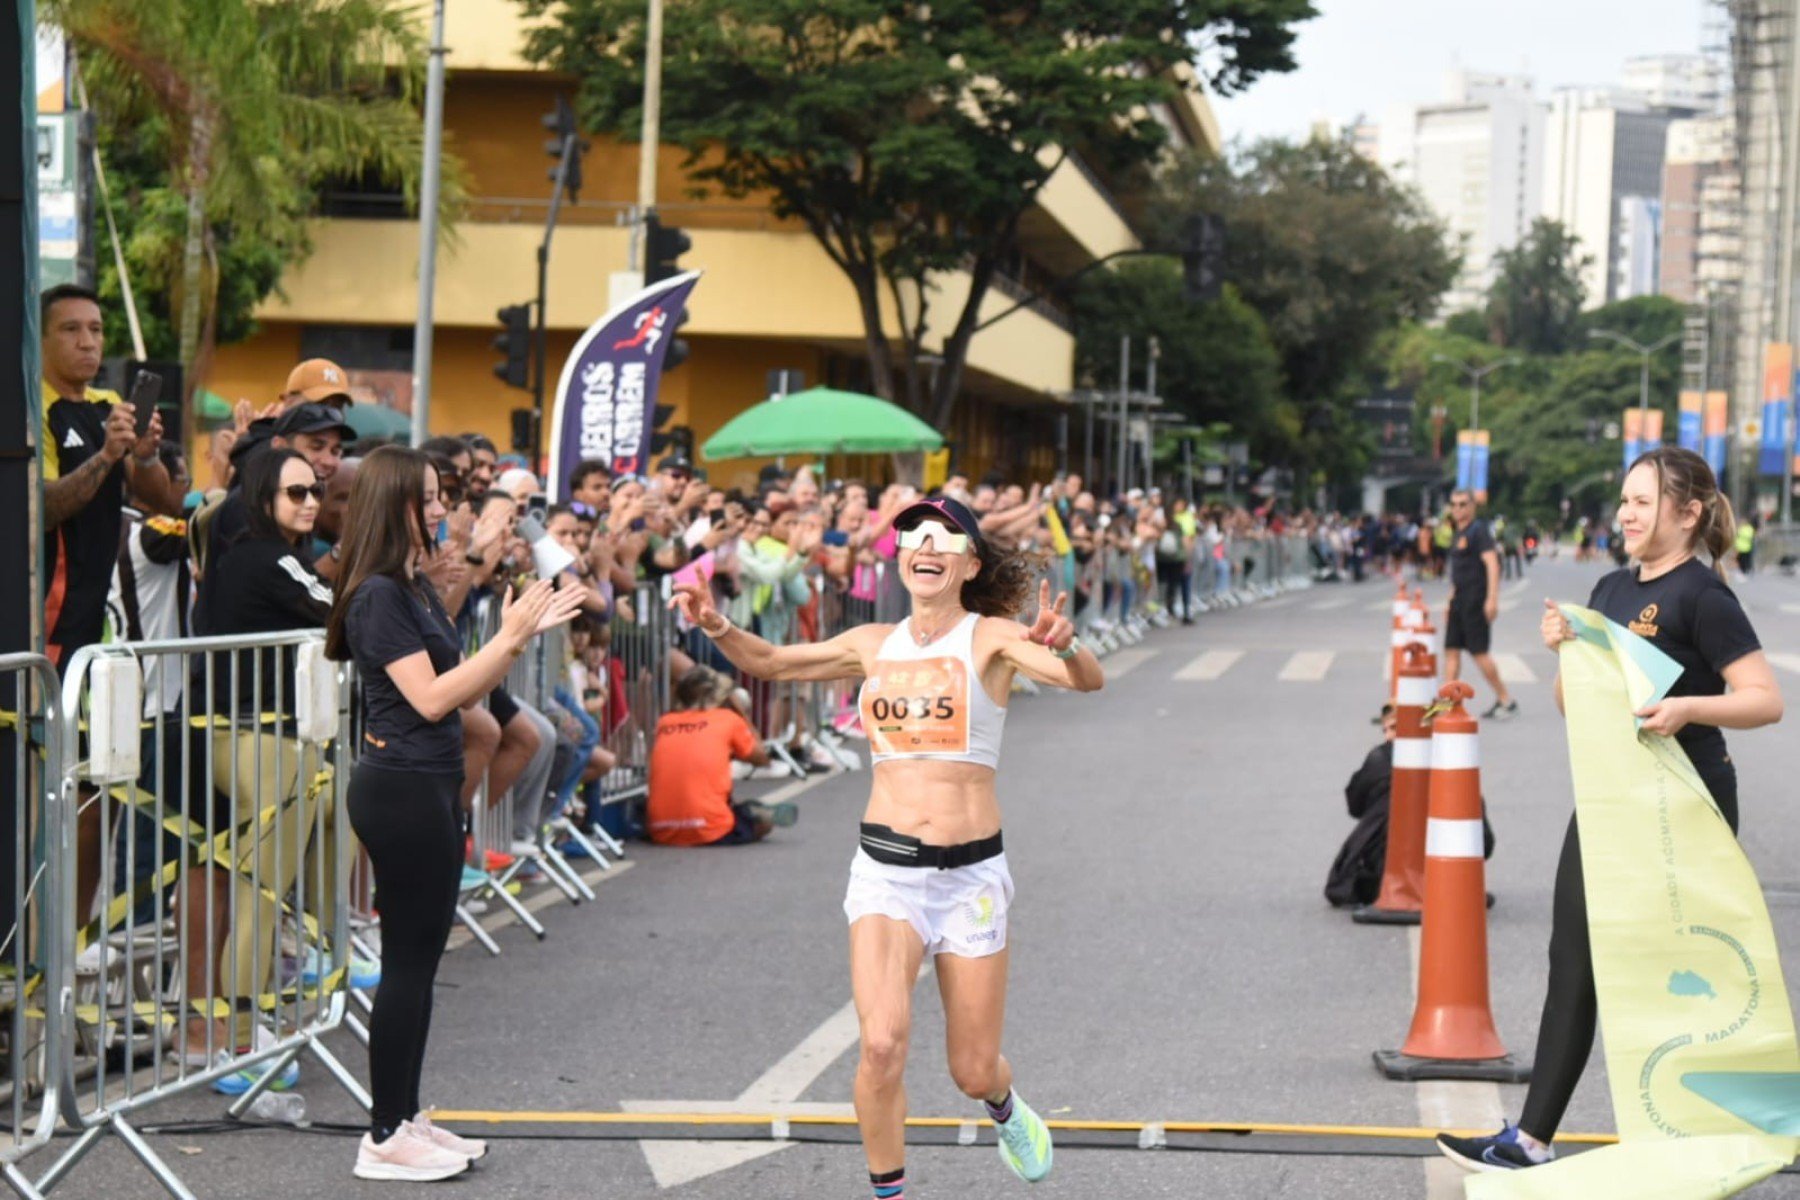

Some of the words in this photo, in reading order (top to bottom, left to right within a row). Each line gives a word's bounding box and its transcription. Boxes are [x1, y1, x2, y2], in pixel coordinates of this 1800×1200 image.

[613, 362, 646, 473] CORREM
[872, 696, 954, 720] 0035
[1705, 979, 1760, 1044] MARATONA
